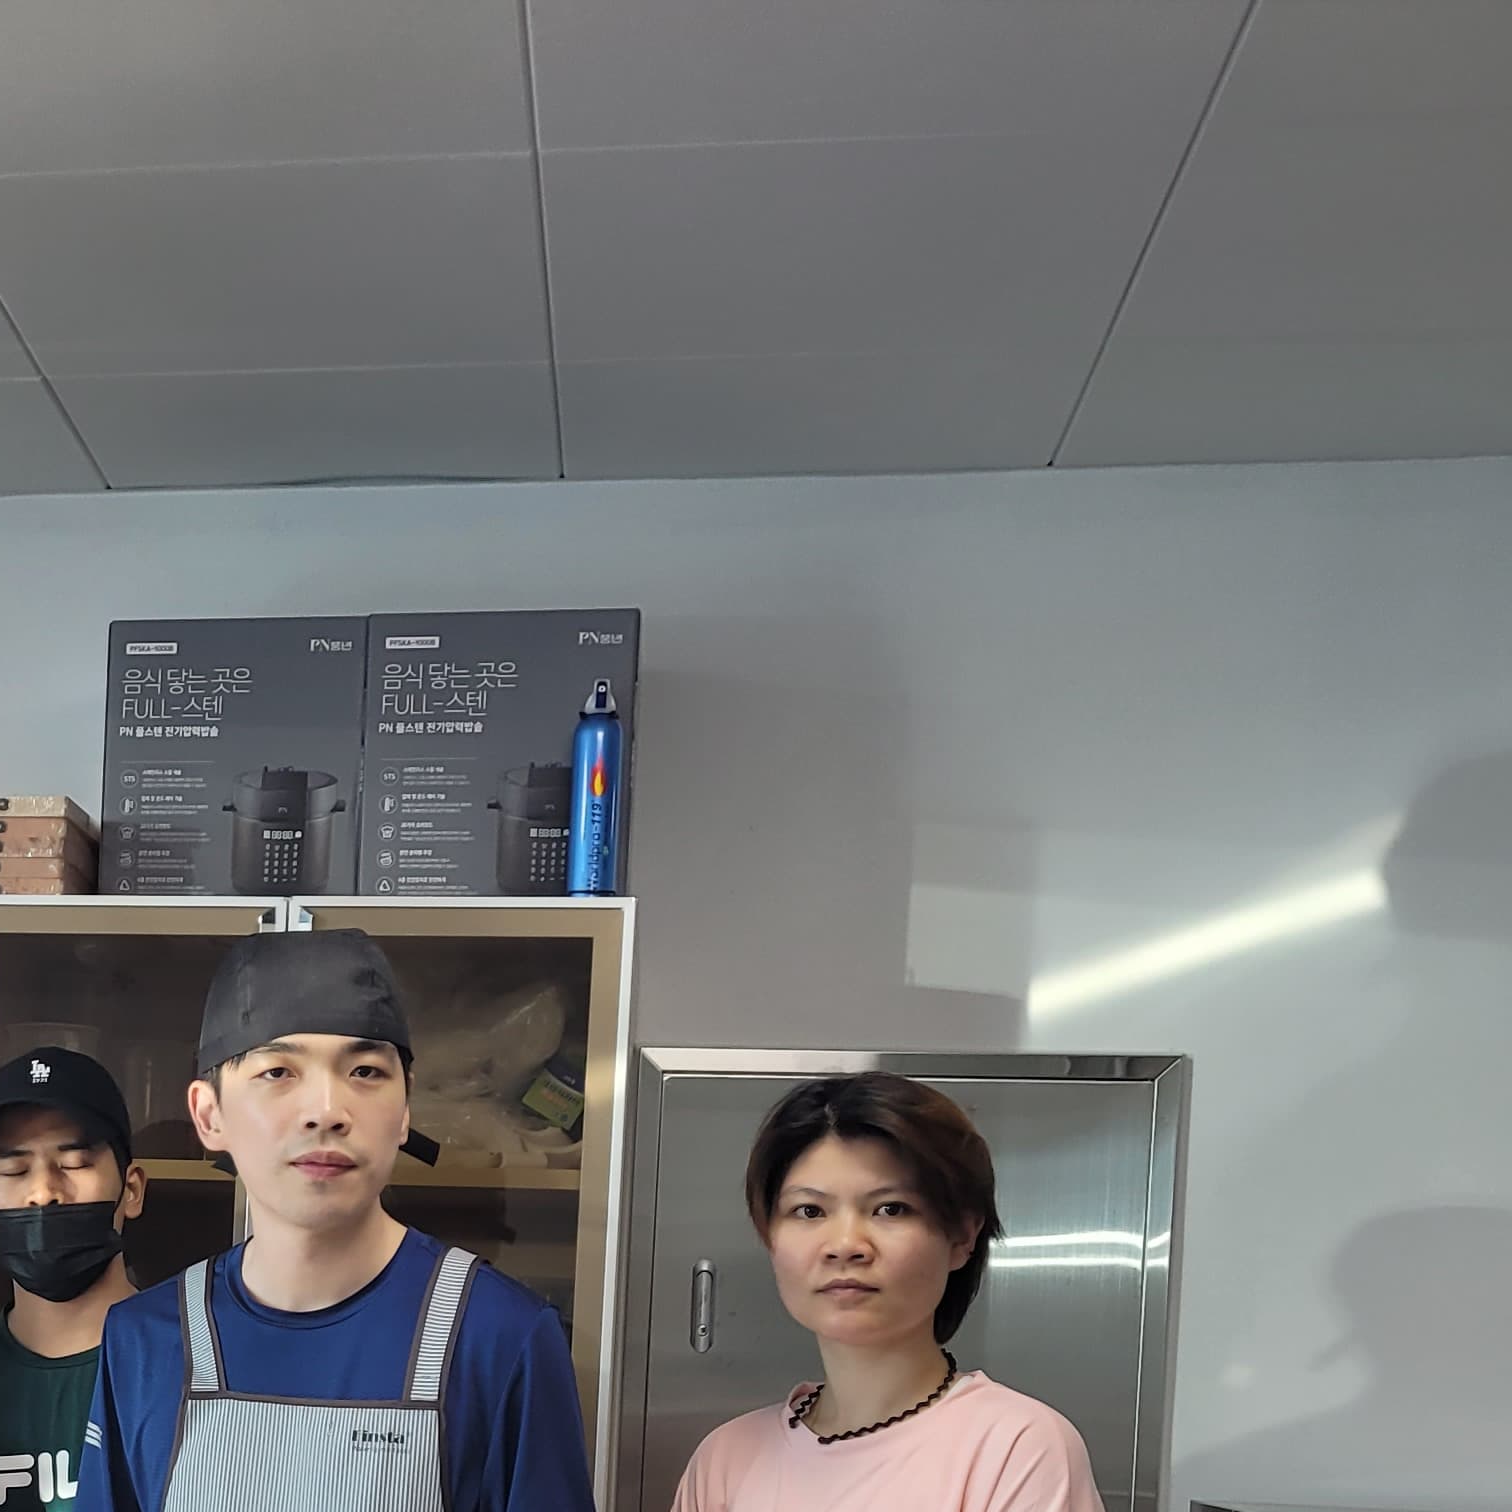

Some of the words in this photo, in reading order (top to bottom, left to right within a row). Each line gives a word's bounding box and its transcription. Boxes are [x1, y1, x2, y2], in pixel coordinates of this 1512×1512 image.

[122, 668, 162, 694] 음식
[167, 668, 208, 694] 닿는
[210, 668, 253, 693] 곳은
[381, 663, 423, 690] 음식
[429, 662, 472, 689] 닿는
[474, 662, 518, 688] 곳은
[122, 695, 223, 720] FULL-스텐
[381, 690, 487, 716] FULL-스텐
[119, 726, 133, 736] PN
[378, 722, 393, 733] PN
